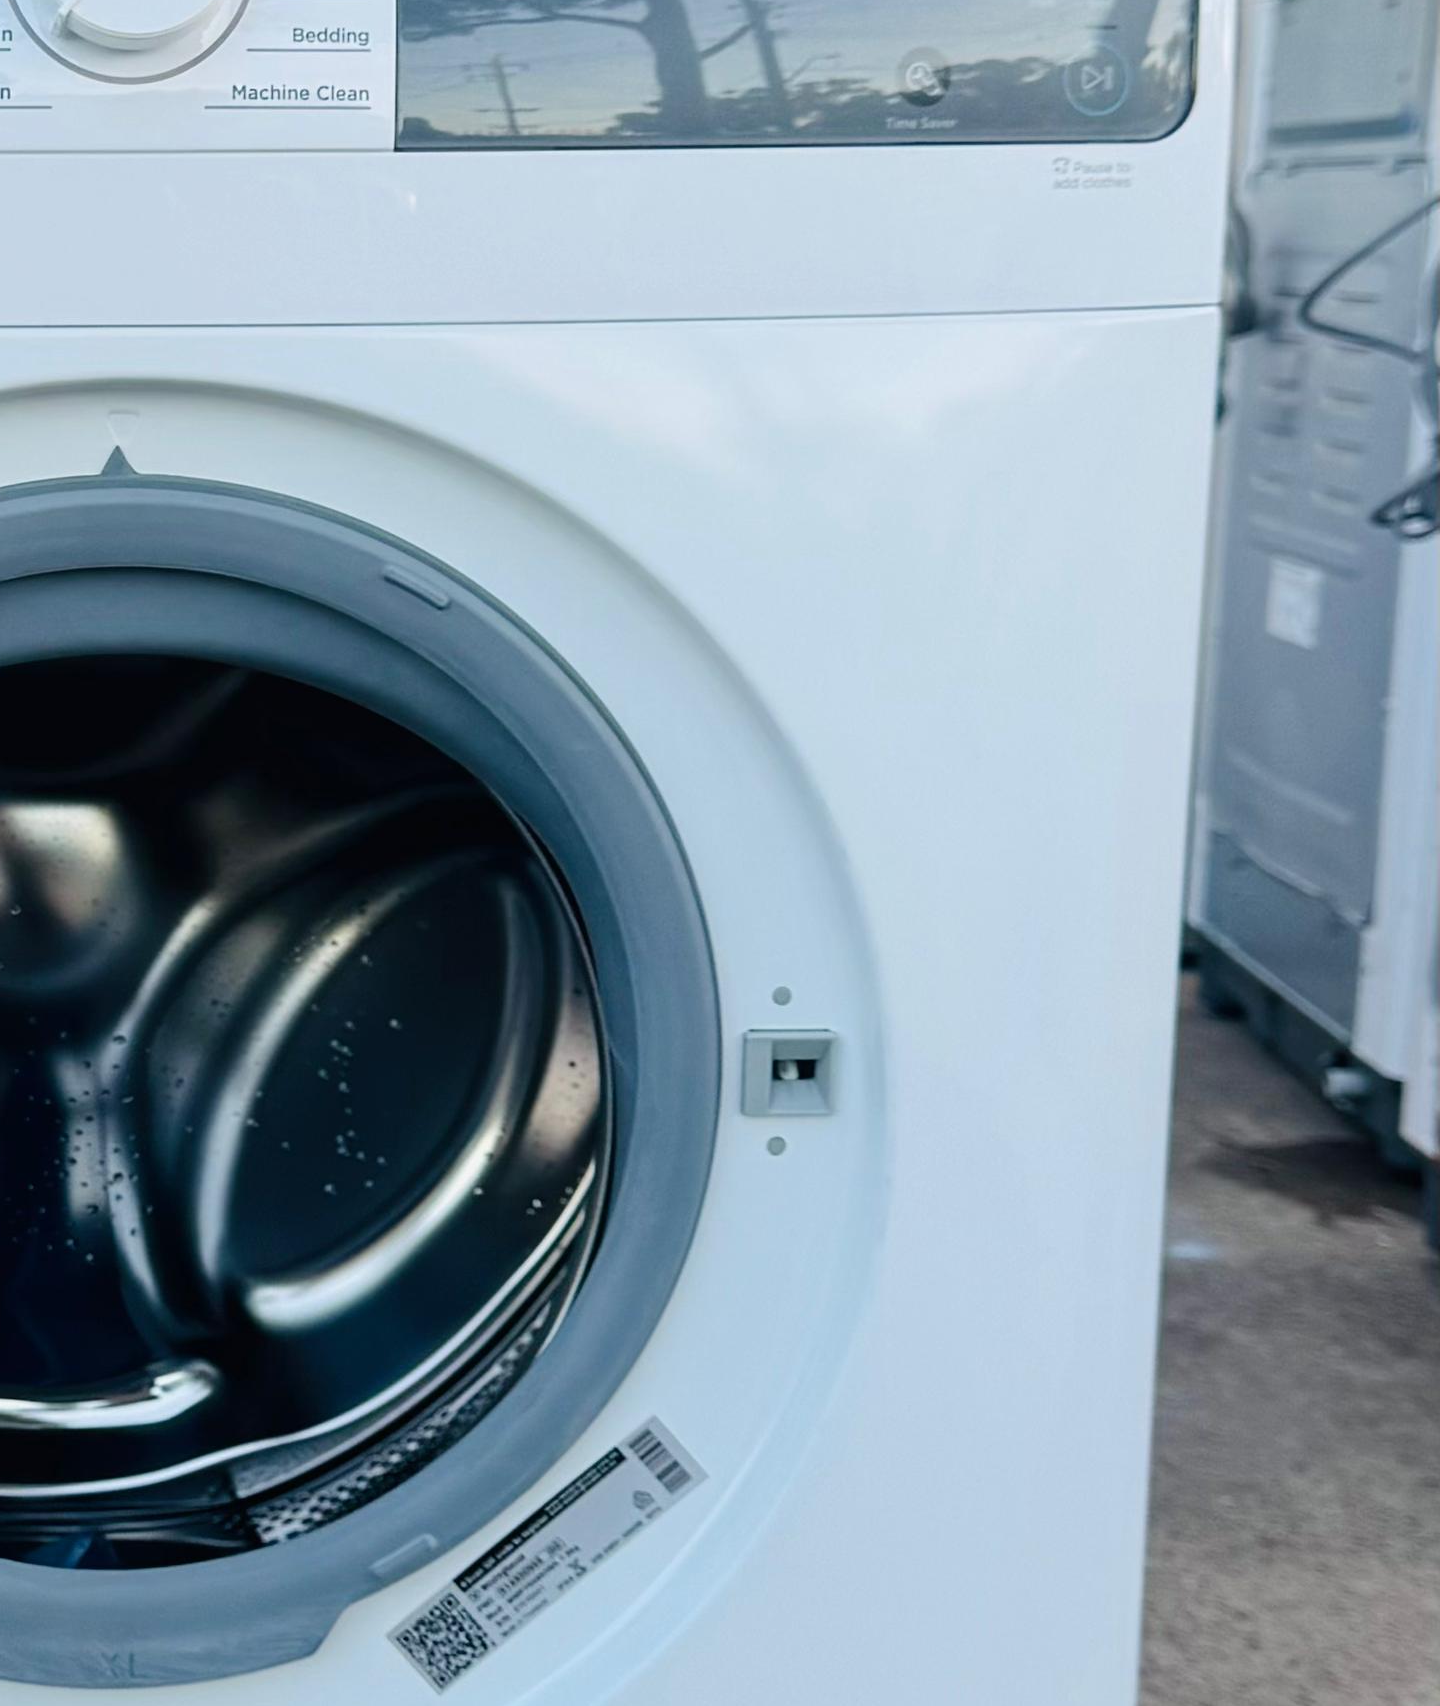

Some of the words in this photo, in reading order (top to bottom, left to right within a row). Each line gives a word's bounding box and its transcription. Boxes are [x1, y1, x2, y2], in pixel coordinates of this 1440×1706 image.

[292, 27, 370, 47] Bedding
[231, 84, 311, 101] Machine
[316, 84, 370, 101] Clean
[885, 116, 917, 130] Time
